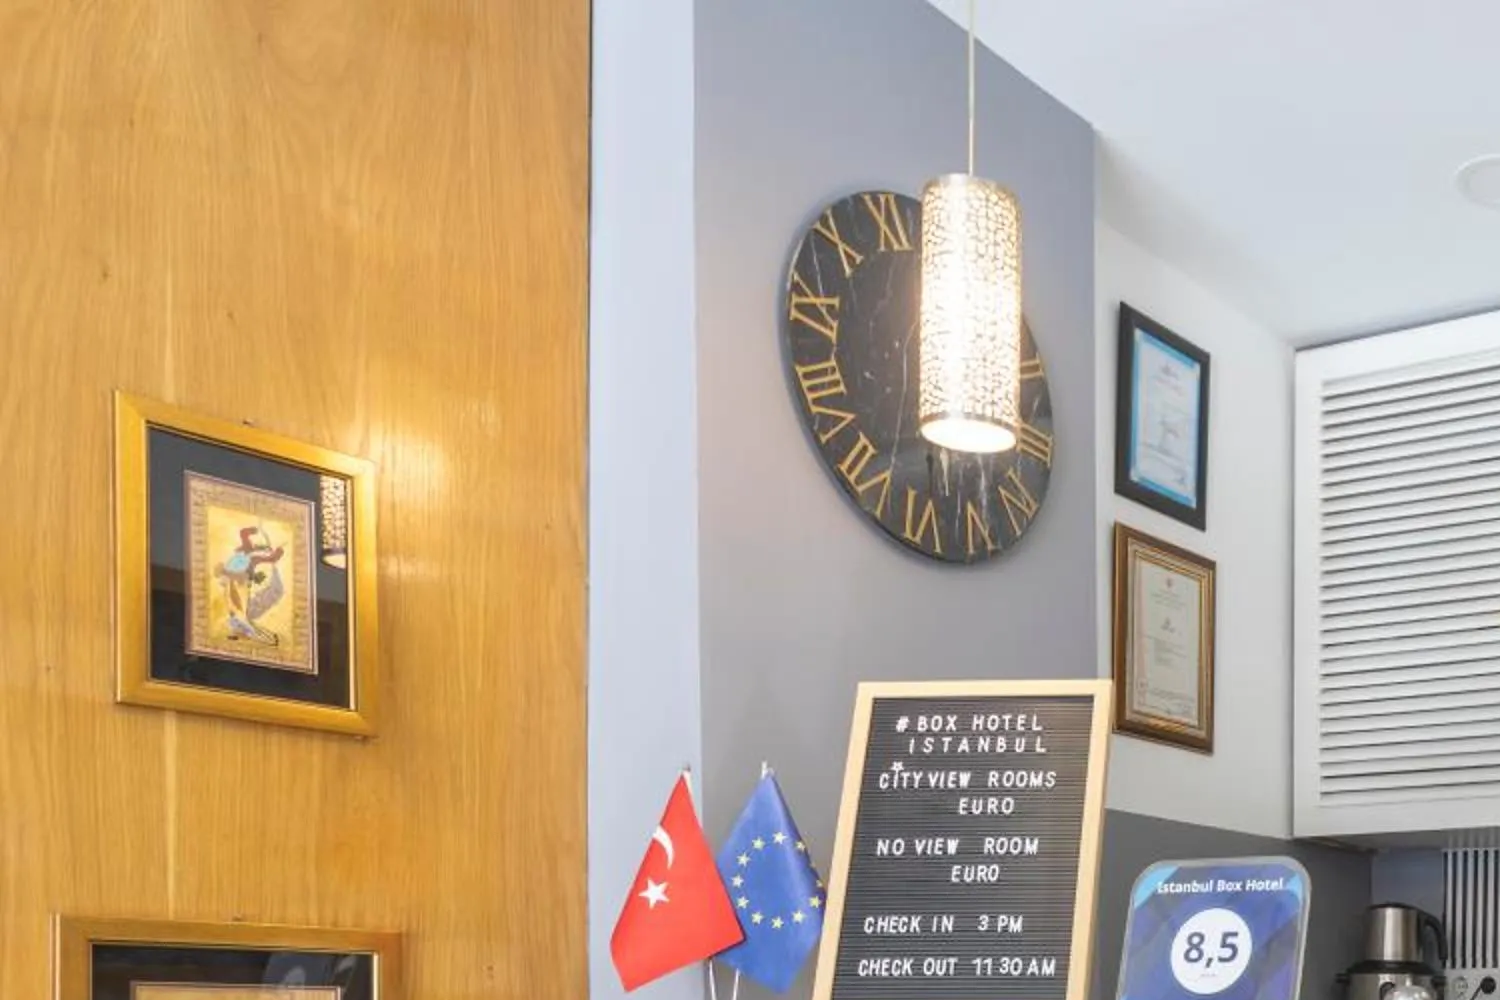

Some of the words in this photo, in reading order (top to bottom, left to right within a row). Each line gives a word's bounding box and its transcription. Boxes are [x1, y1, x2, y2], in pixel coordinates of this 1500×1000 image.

[811, 206, 865, 279] X
[972, 714, 1042, 731] HOTEL
[909, 736, 1047, 754] ISTANBUL
[988, 770, 1057, 788] ROOMS
[959, 797, 1015, 815] EURO
[877, 839, 904, 856] NO
[915, 838, 959, 855] VIEW
[984, 837, 1039, 855] ROOM
[951, 864, 1000, 882] EURO
[1157, 879, 1213, 893] Istanbul
[1217, 879, 1243, 892] Box
[1246, 877, 1284, 891] Hotel
[864, 915, 921, 934] CHECK
[932, 915, 954, 933] IN
[977, 915, 990, 931] 3
[997, 915, 1023, 933] PM
[1183, 931, 1239, 968] 8,5
[858, 957, 914, 976] CHECK
[923, 957, 958, 976] OUT
[1027, 957, 1056, 976] AM
